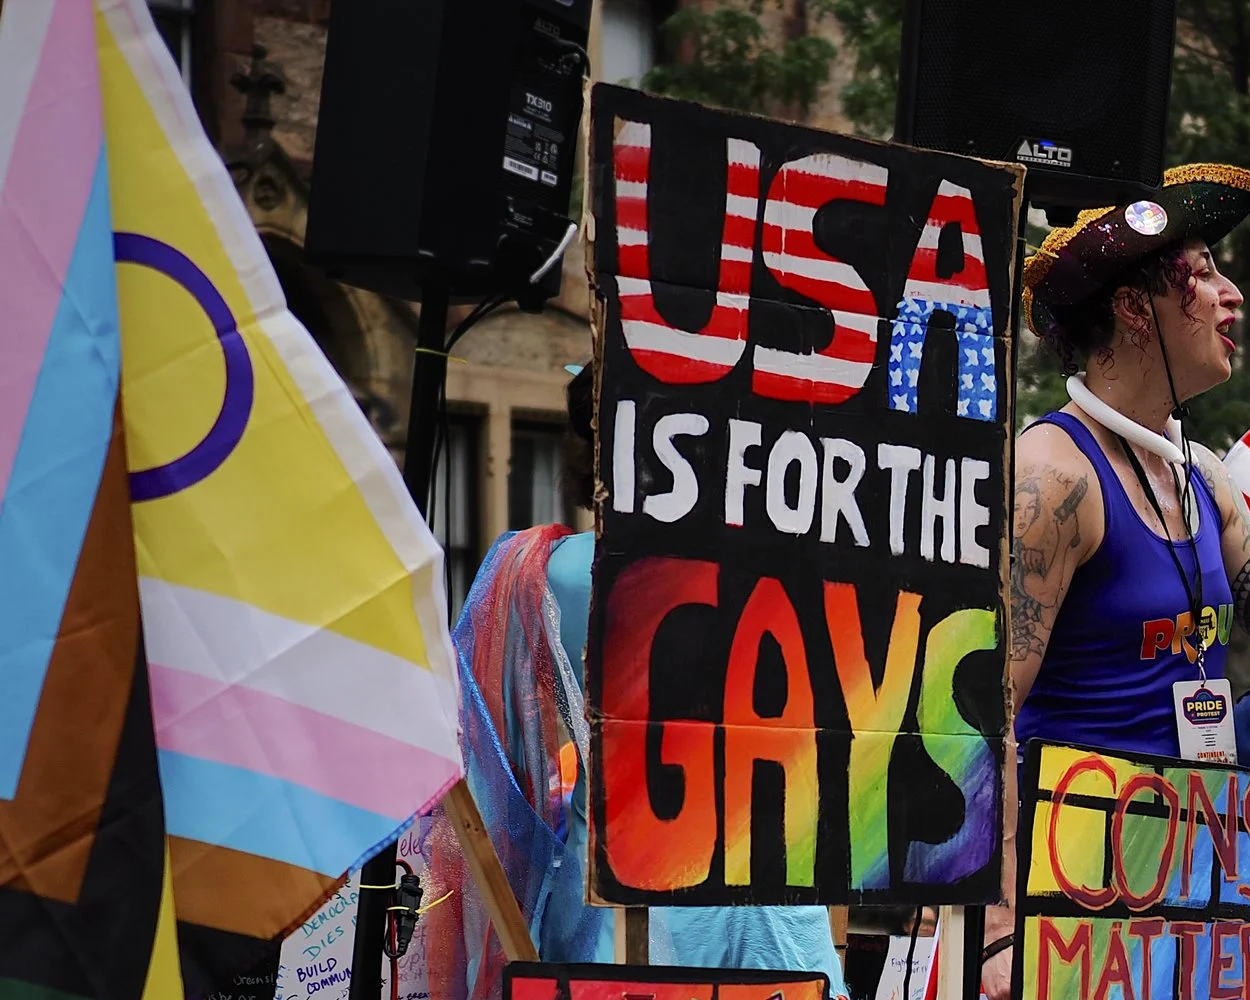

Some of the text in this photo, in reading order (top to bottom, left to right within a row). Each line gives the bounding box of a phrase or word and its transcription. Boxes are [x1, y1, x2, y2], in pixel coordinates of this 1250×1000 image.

[525, 92, 552, 112] TX310
[1017, 139, 1072, 162] ALTO
[613, 114, 997, 422] USA
[613, 400, 991, 569] IS FOR THE
[1187, 701, 1223, 712] PRIDE
[602, 556, 998, 891] GAYS
[303, 925, 344, 961] DIES
[296, 957, 337, 983] BUILD
